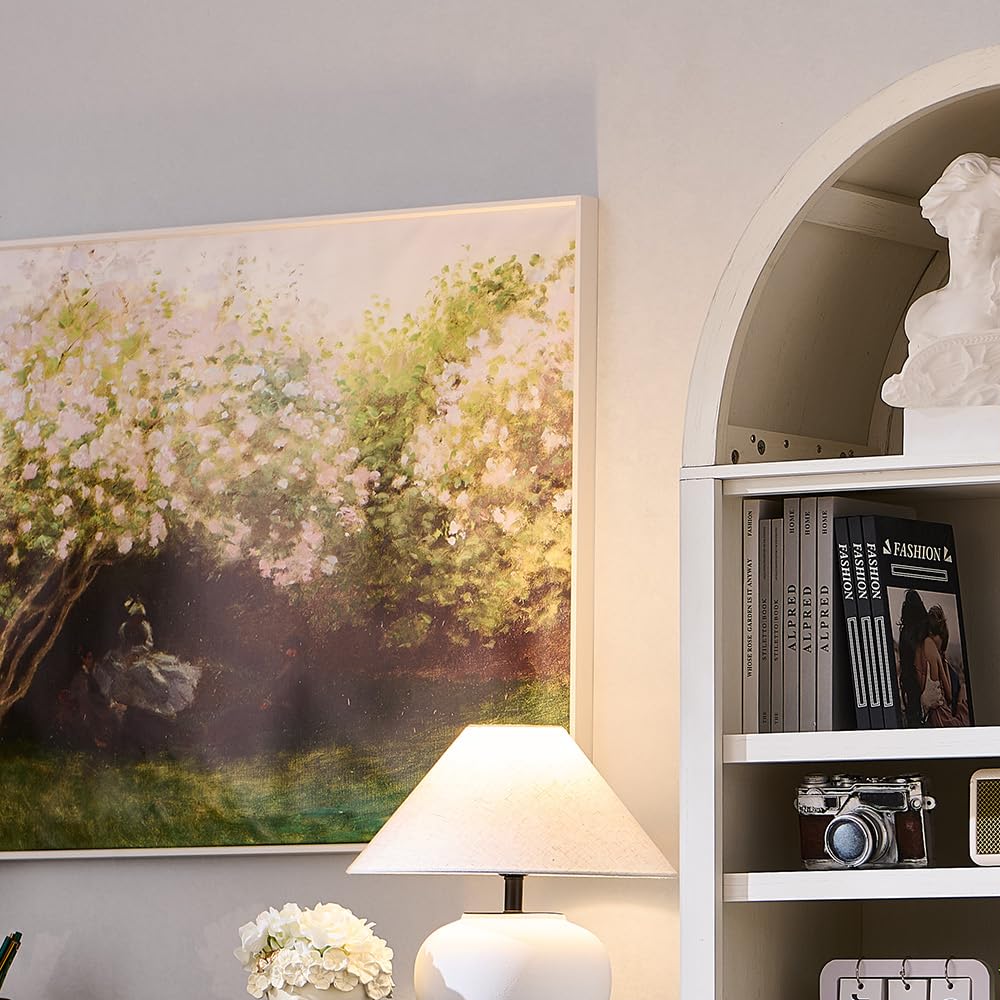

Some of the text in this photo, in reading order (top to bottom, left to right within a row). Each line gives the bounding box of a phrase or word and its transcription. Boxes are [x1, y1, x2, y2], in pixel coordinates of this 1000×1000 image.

[838, 543, 854, 600] FASHION
[853, 543, 868, 600] FASHION
[867, 542, 881, 599] FASHION
[893, 541, 942, 562] FASHION
[788, 584, 797, 651] ALPRED
[803, 587, 812, 653] ALPRED
[820, 585, 829, 653] ALPRED
